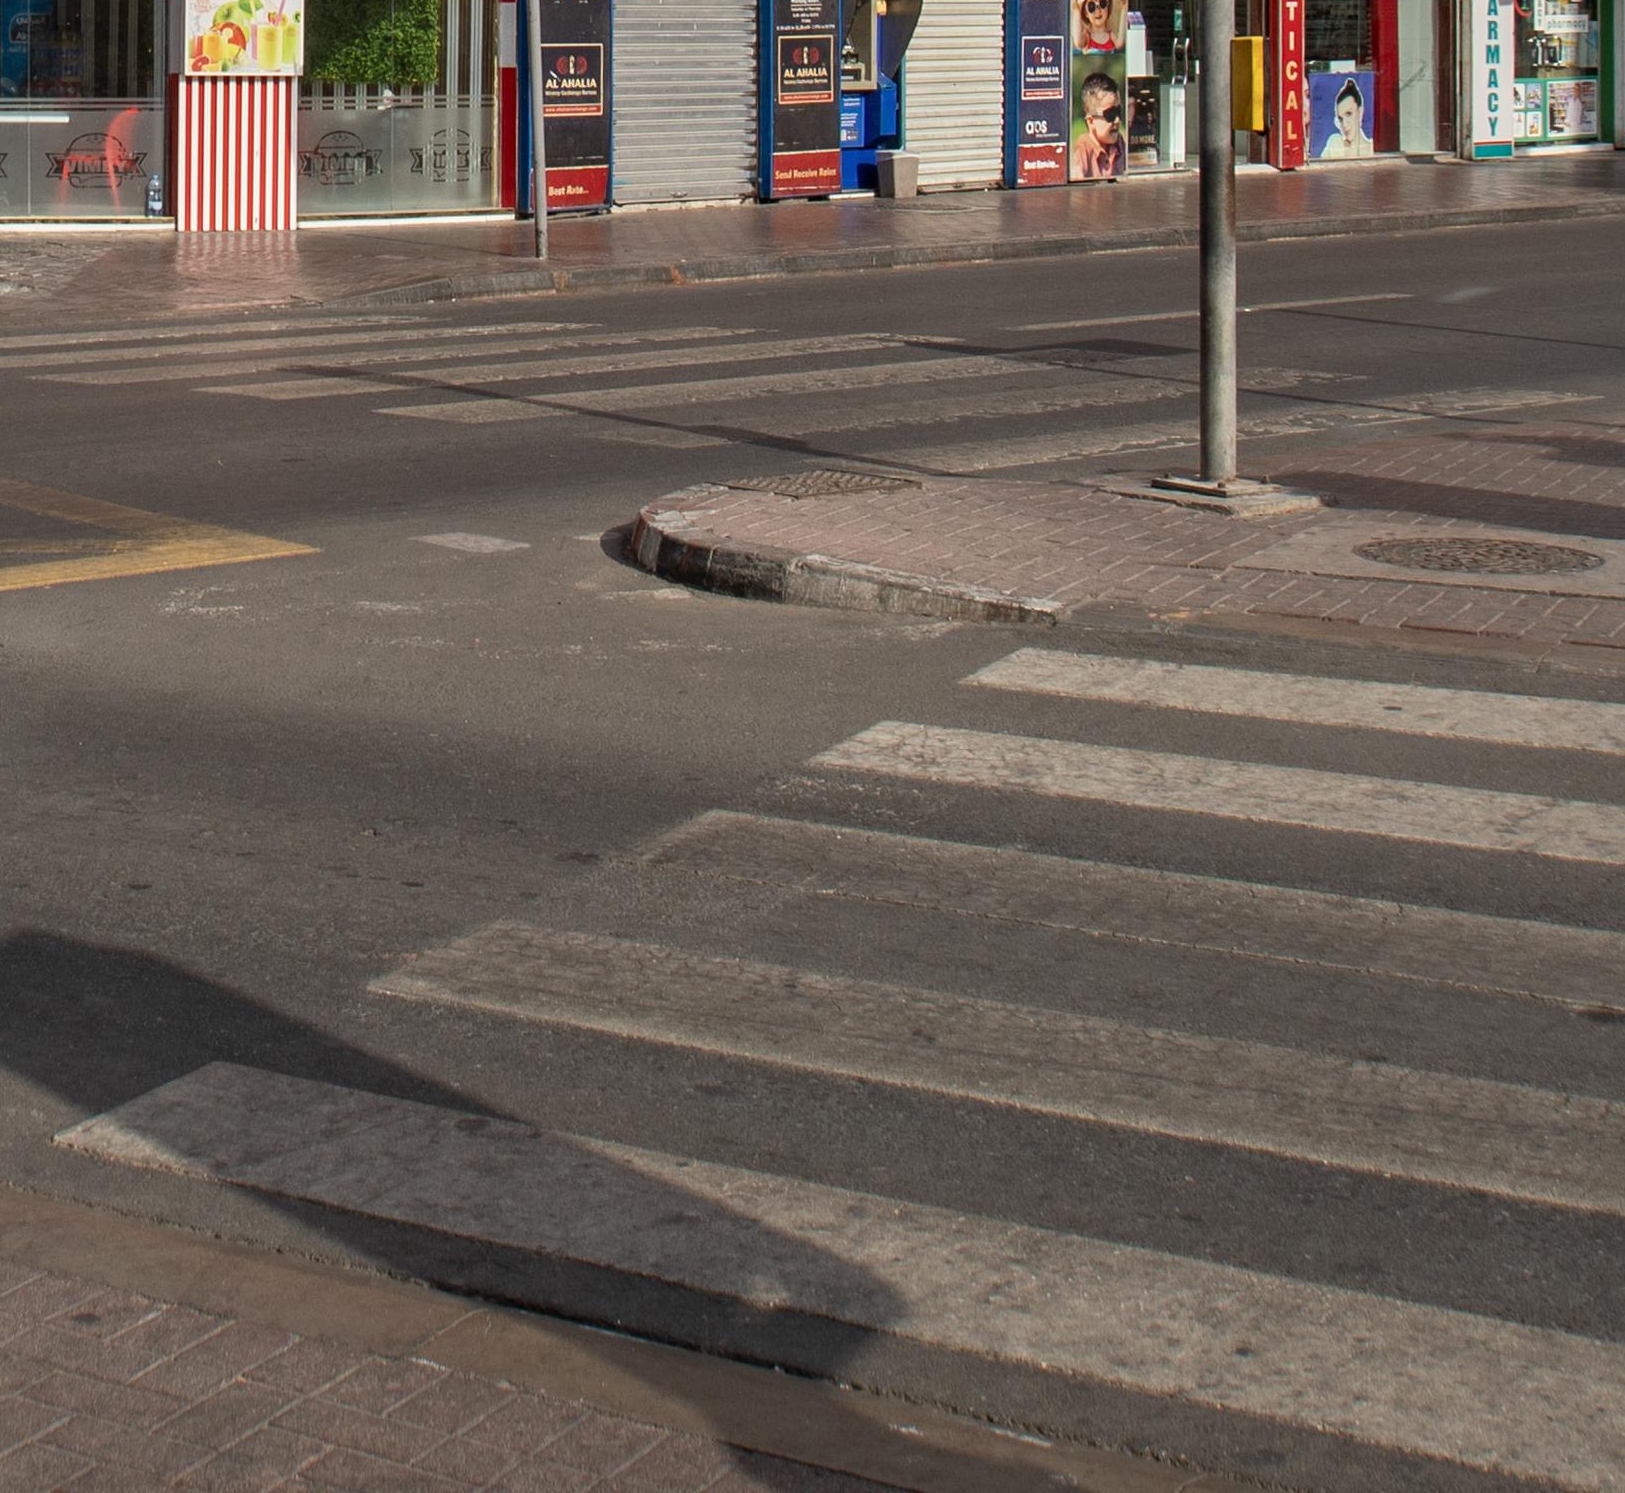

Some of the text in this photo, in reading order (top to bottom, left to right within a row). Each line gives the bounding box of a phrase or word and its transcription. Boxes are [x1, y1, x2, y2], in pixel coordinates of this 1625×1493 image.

[1546, 17, 1587, 31] pharmacy
[783, 67, 828, 78] AL AHALIA
[1025, 66, 1060, 76] AL AHALIA
[545, 78, 597, 89] AL AHALIA
[775, 169, 818, 180] Send Receive
